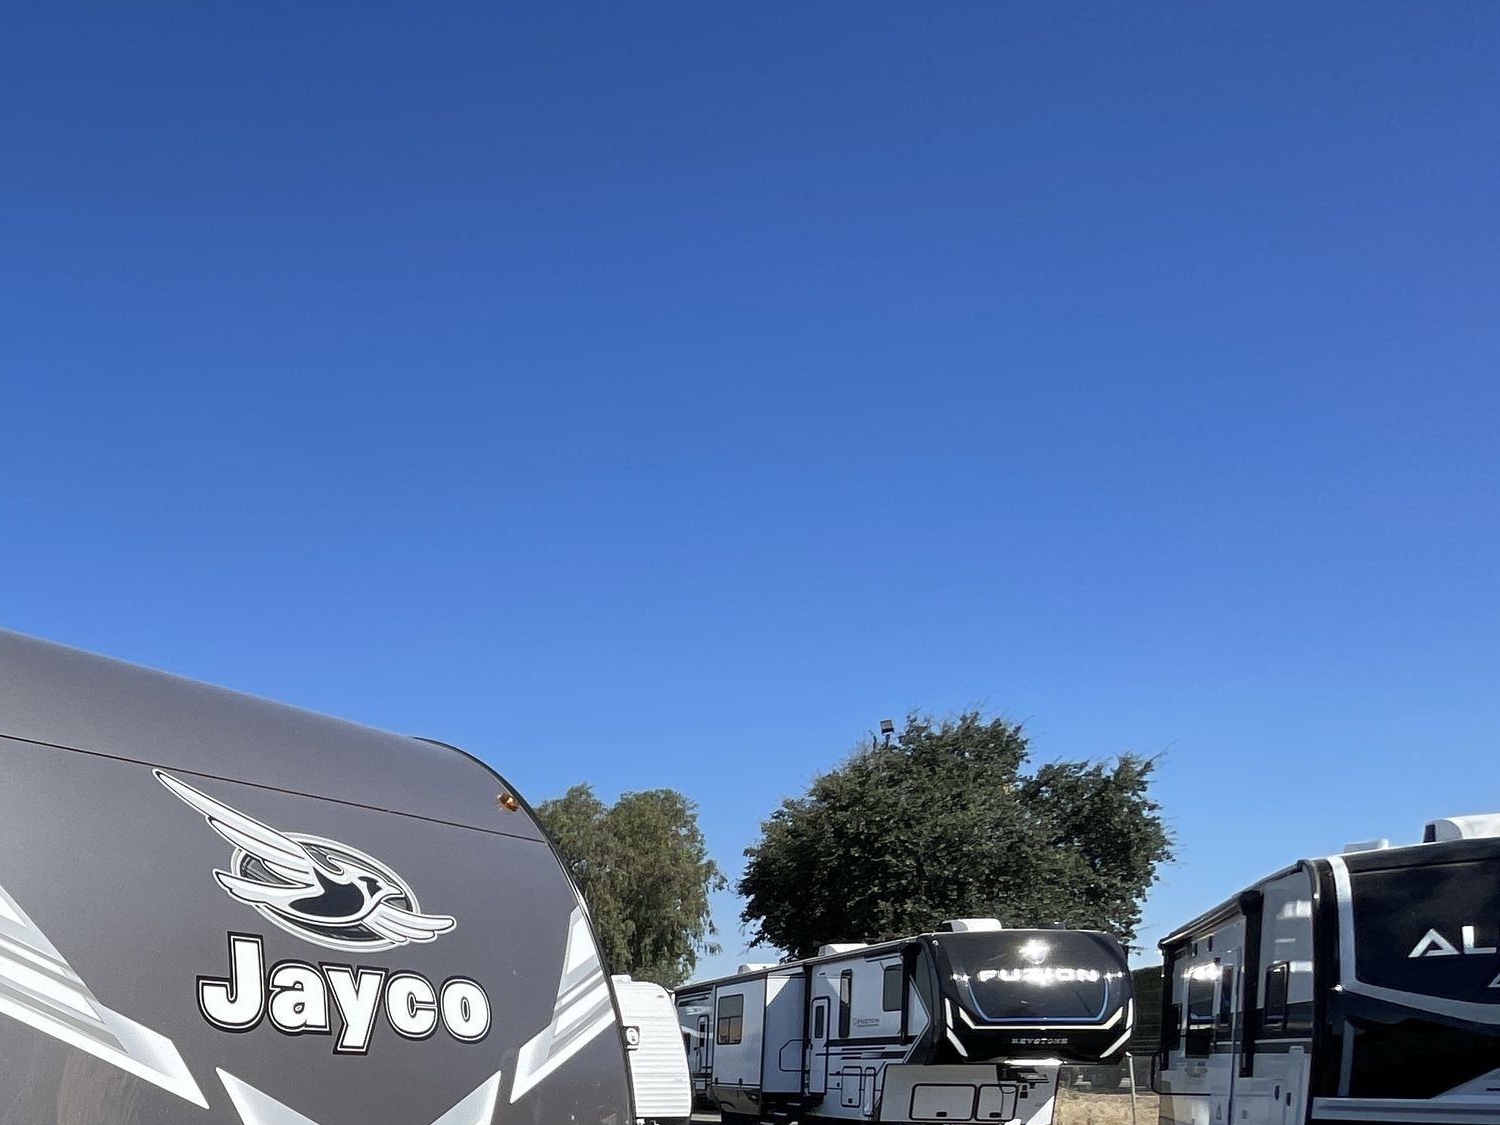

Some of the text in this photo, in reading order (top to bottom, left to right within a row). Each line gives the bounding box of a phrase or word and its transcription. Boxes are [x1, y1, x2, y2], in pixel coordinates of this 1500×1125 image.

[978, 967, 1100, 984] FUZION
[196, 931, 492, 1056] Jayco
[1011, 1037, 1069, 1045] KEYSTONE
